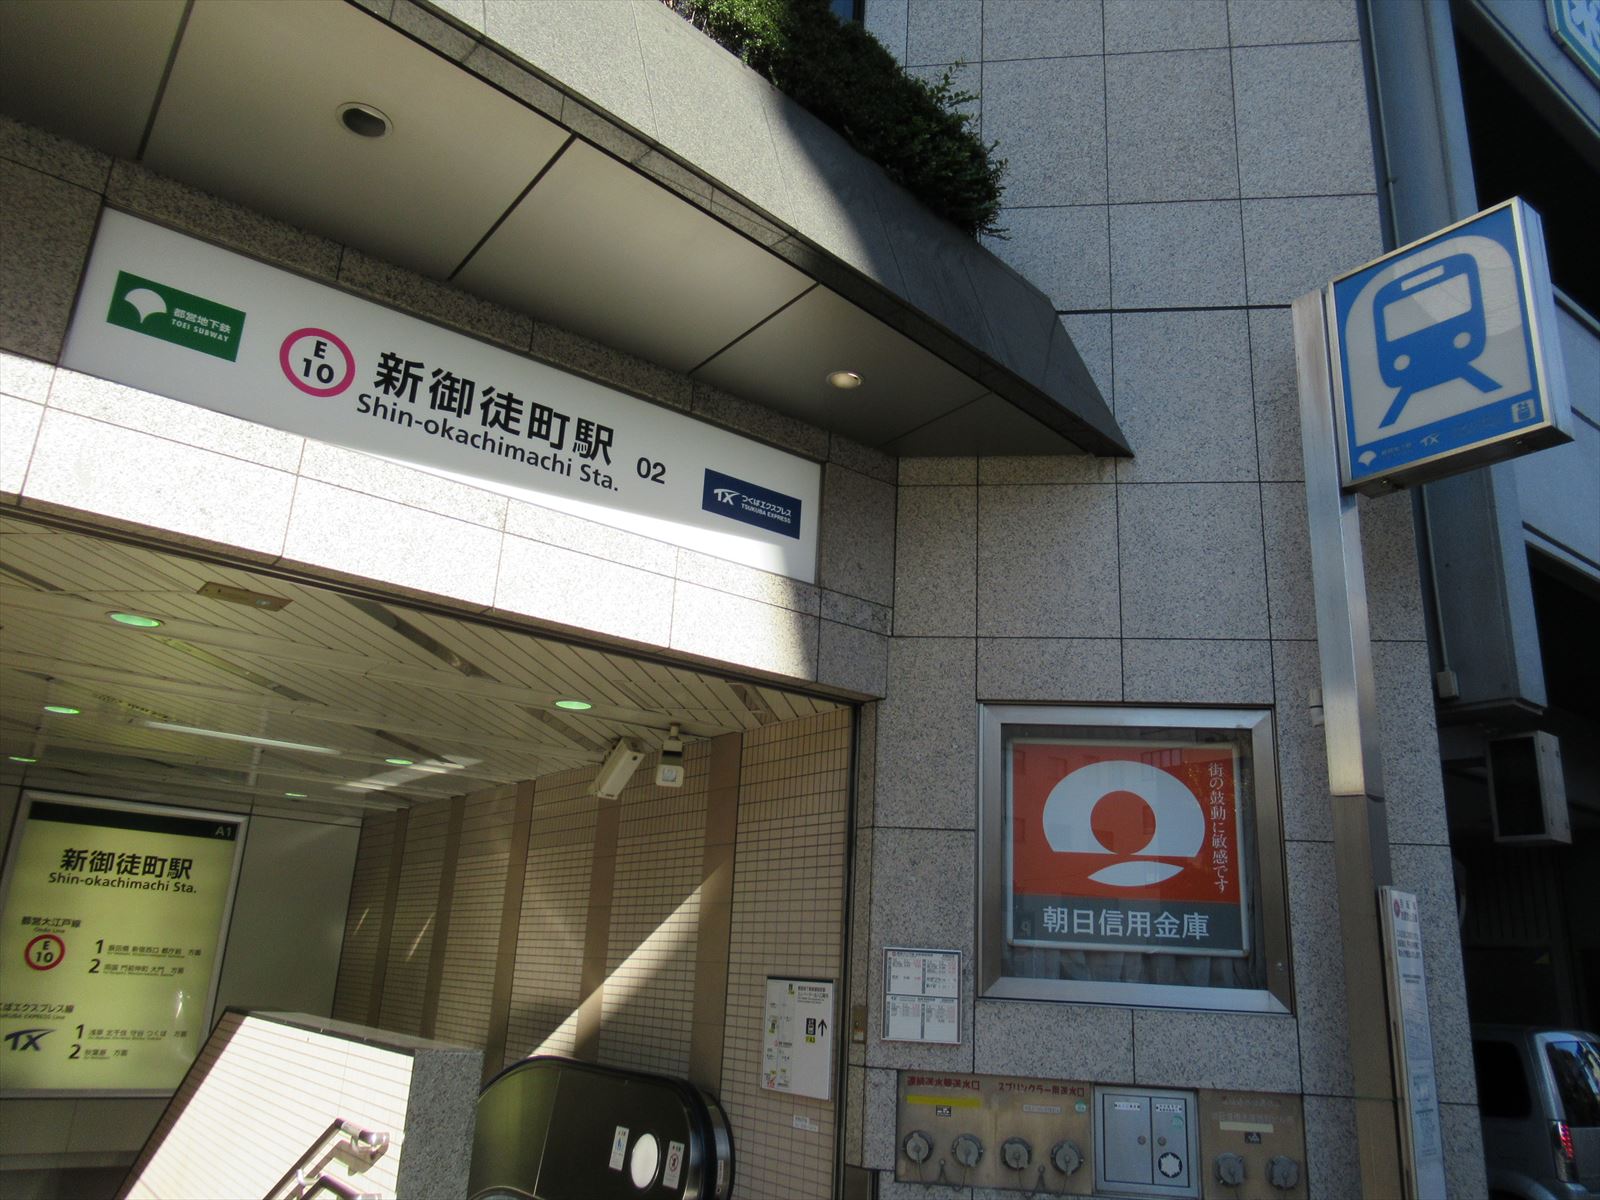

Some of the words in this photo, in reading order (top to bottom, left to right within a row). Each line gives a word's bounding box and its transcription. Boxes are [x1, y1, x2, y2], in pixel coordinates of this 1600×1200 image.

[172, 318, 191, 330] TOEI
[193, 326, 229, 342] SUBWAY
[173, 308, 232, 334] 都営地下鉄
[314, 340, 328, 359] E
[302, 358, 334, 384] 10
[373, 352, 615, 466] 新御徒町駅
[356, 394, 572, 478] Shin-okachimachi
[579, 464, 619, 492] Sta.
[636, 456, 666, 484] 02
[713, 488, 741, 505] TX
[741, 494, 792, 517] つくばエクスプレス
[741, 504, 766, 516] TSUKUBA
[767, 512, 791, 523] EXPRESS
[214, 825, 233, 839] A1
[1208, 762, 1229, 894] 街の鼓動に敏感です
[60, 847, 193, 880] 新御徒町駅
[48, 872, 171, 892] Shin-okachimachi
[172, 881, 197, 894] Sta.
[1042, 906, 1210, 939] 朝日信用金庫
[43, 940, 50, 950] E
[95, 939, 104, 954] 1
[35, 951, 54, 963] 10
[88, 958, 101, 974] 2
[4, 1028, 56, 1051] TX
[75, 1024, 85, 1039] 1
[68, 1044, 81, 1059] 2
